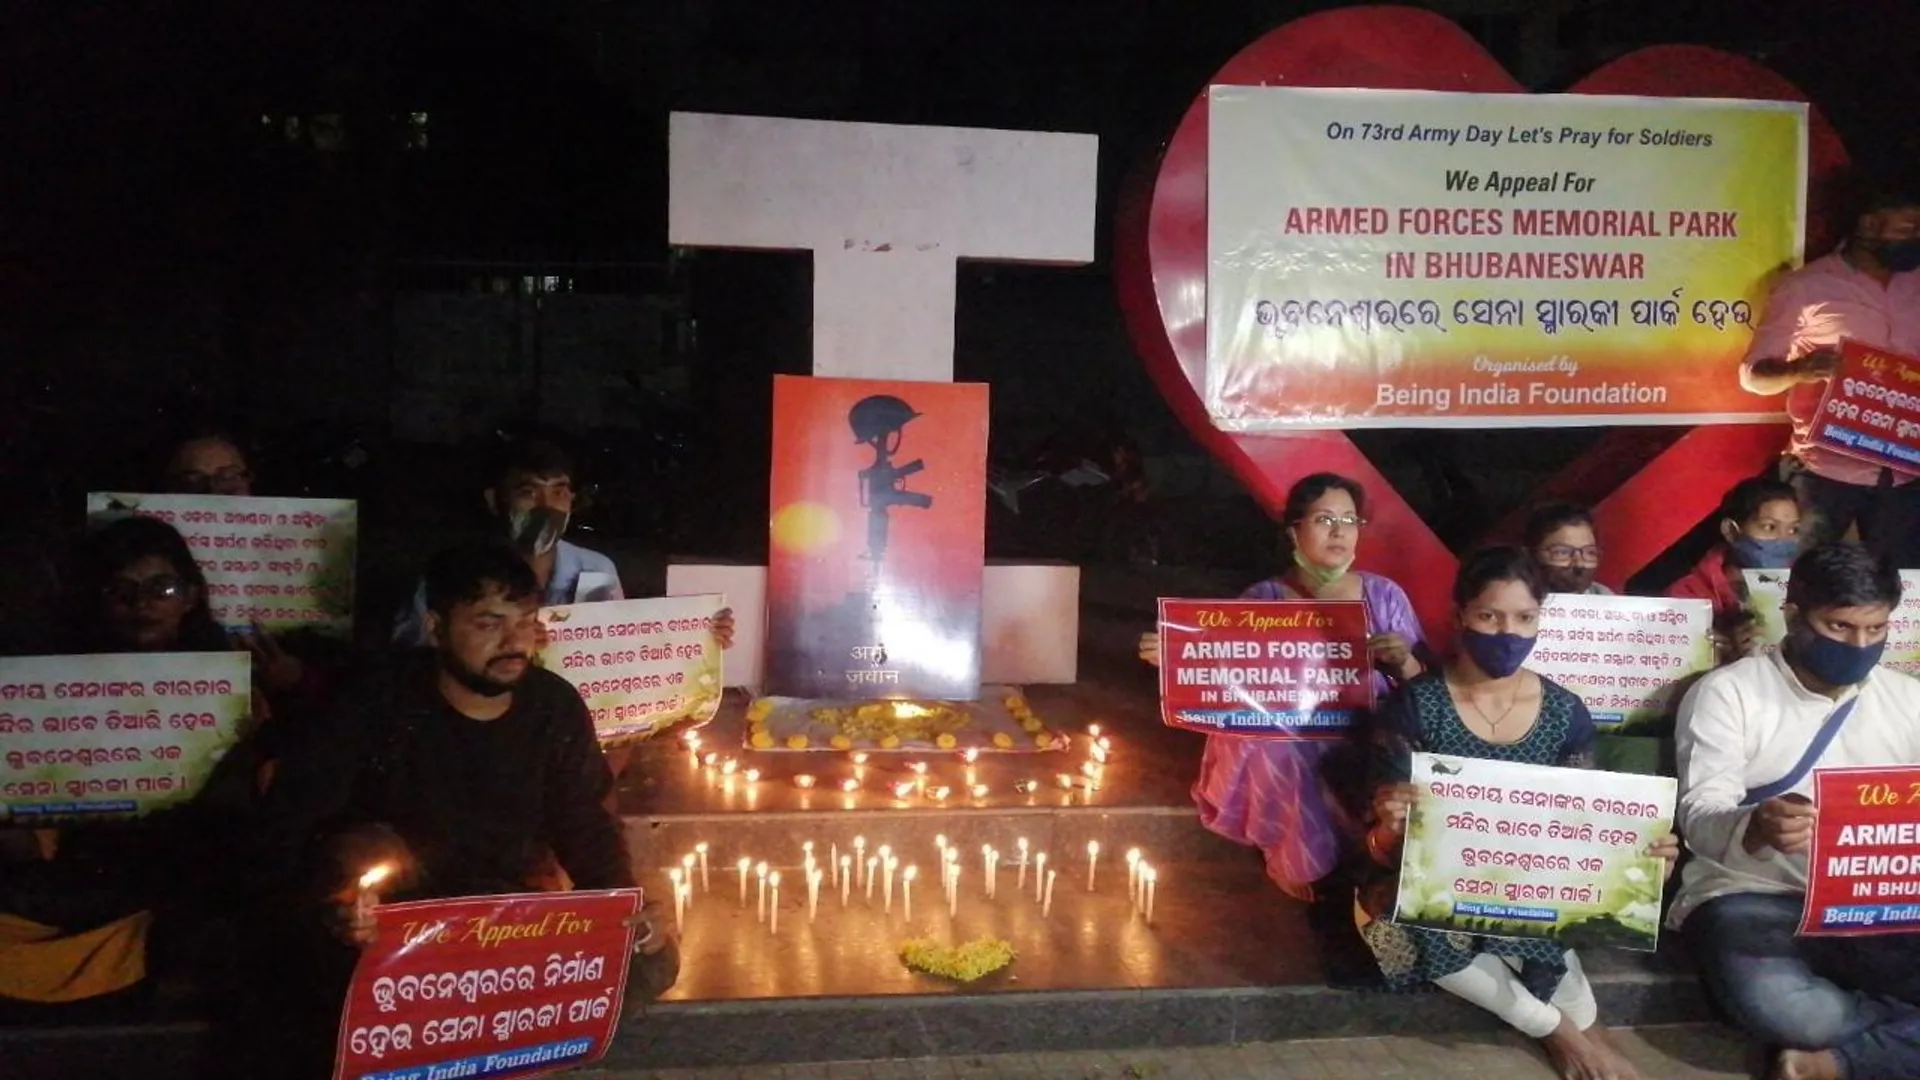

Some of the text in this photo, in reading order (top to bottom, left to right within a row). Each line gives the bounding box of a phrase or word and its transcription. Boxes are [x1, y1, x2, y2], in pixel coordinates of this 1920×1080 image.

[1326, 121, 1714, 149] On 73rd Army Day Let's Pray for Soldiers
[1445, 170, 1597, 198] We Appeal For
[1283, 206, 1739, 238] ARMED FORCES MEMORIAL PARK
[1385, 251, 1645, 279] IN BHUBANESWAR
[1453, 298, 1524, 326] ସେନା
[1535, 298, 1619, 335] ସ୍ମାରକୀ
[1630, 286, 1684, 327] ପାର୍କ
[1691, 298, 1757, 332] ହେଉ
[1473, 354, 1580, 378] Organised by
[1376, 381, 1667, 410] Being India Foundation
[1196, 609, 1335, 633] We Appeal For
[1181, 641, 1353, 660] ARMED FORCES
[845, 669, 900, 685] जवान
[1176, 667, 1361, 686] MEMORIAL PARK
[1200, 690, 1218, 703] IN
[1275, 711, 1351, 727] Foundatio
[1429, 781, 1660, 819] ଭାରତୀୟ ସେନାଙ୍କର ବୀରତାର
[1857, 783, 1899, 806] We
[1446, 811, 1638, 846] ମନ୍ଦିର ଭାବେ ତିଆରି ହେଉ
[1836, 823, 1920, 846] ARME
[1576, 857, 1604, 872] ଏକ
[1453, 877, 1498, 896] ସେନା
[1852, 882, 1872, 897] IN
[1824, 905, 1920, 926] Being Indi
[460, 912, 551, 948] Appeal
[555, 911, 594, 936] For
[543, 950, 606, 987] ନିର୍ମାଣ
[350, 1022, 413, 1059] ହେଉ
[422, 1014, 486, 1046] ସେନା
[568, 987, 615, 1023] ପାର୍କ
[427, 1058, 478, 1080] India
[482, 1041, 589, 1073] Foundation
